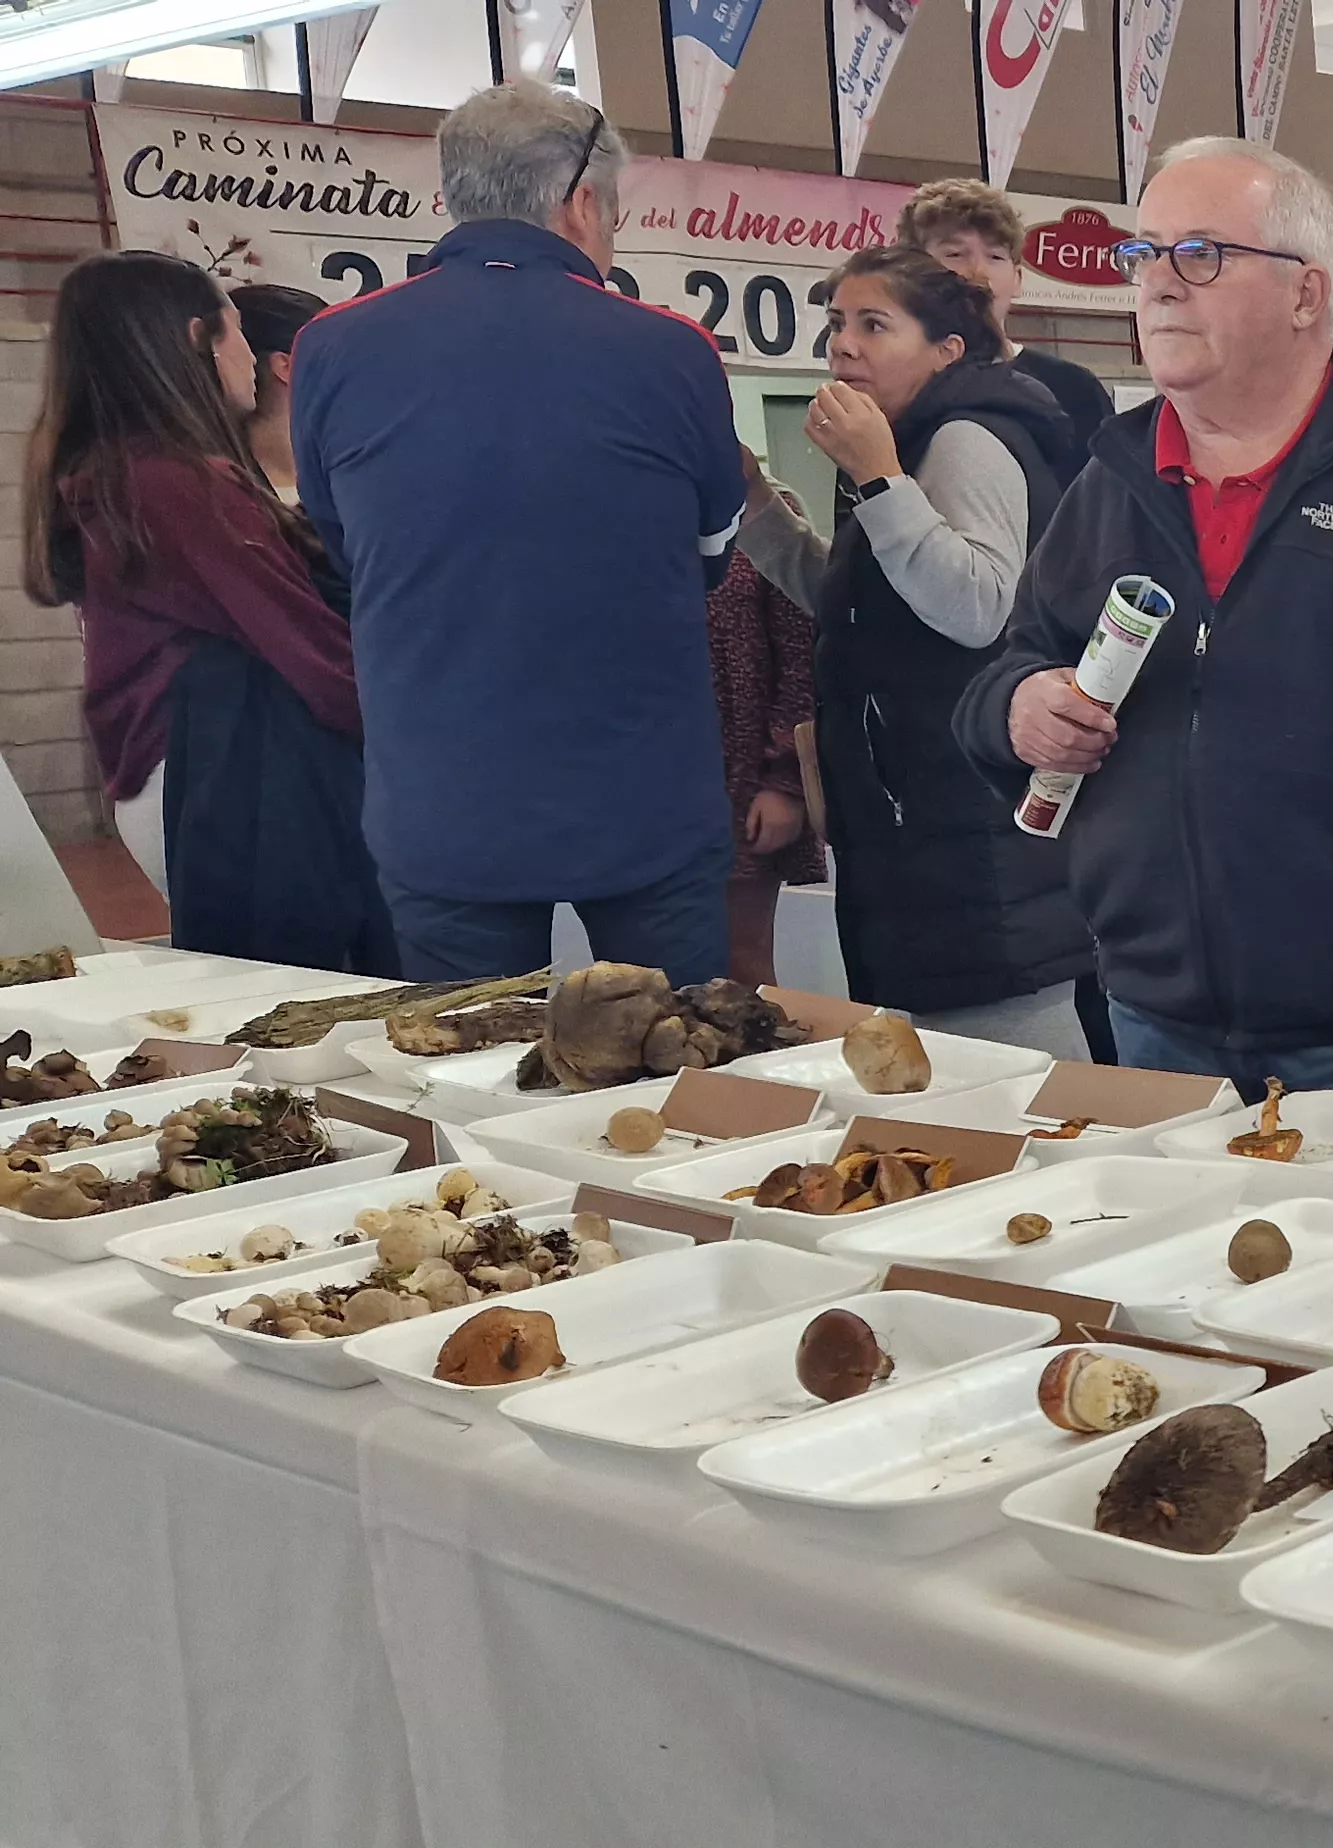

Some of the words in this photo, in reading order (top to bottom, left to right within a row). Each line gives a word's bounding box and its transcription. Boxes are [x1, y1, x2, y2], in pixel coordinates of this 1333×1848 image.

[838, 24, 872, 94] Gigantes
[863, 36, 893, 97] Ayerbe
[172, 129, 353, 166] PRÓXIMA
[123, 145, 422, 219] Caminata
[640, 207, 678, 230] del
[686, 190, 897, 252] almendr
[1071, 212, 1100, 227] 1876
